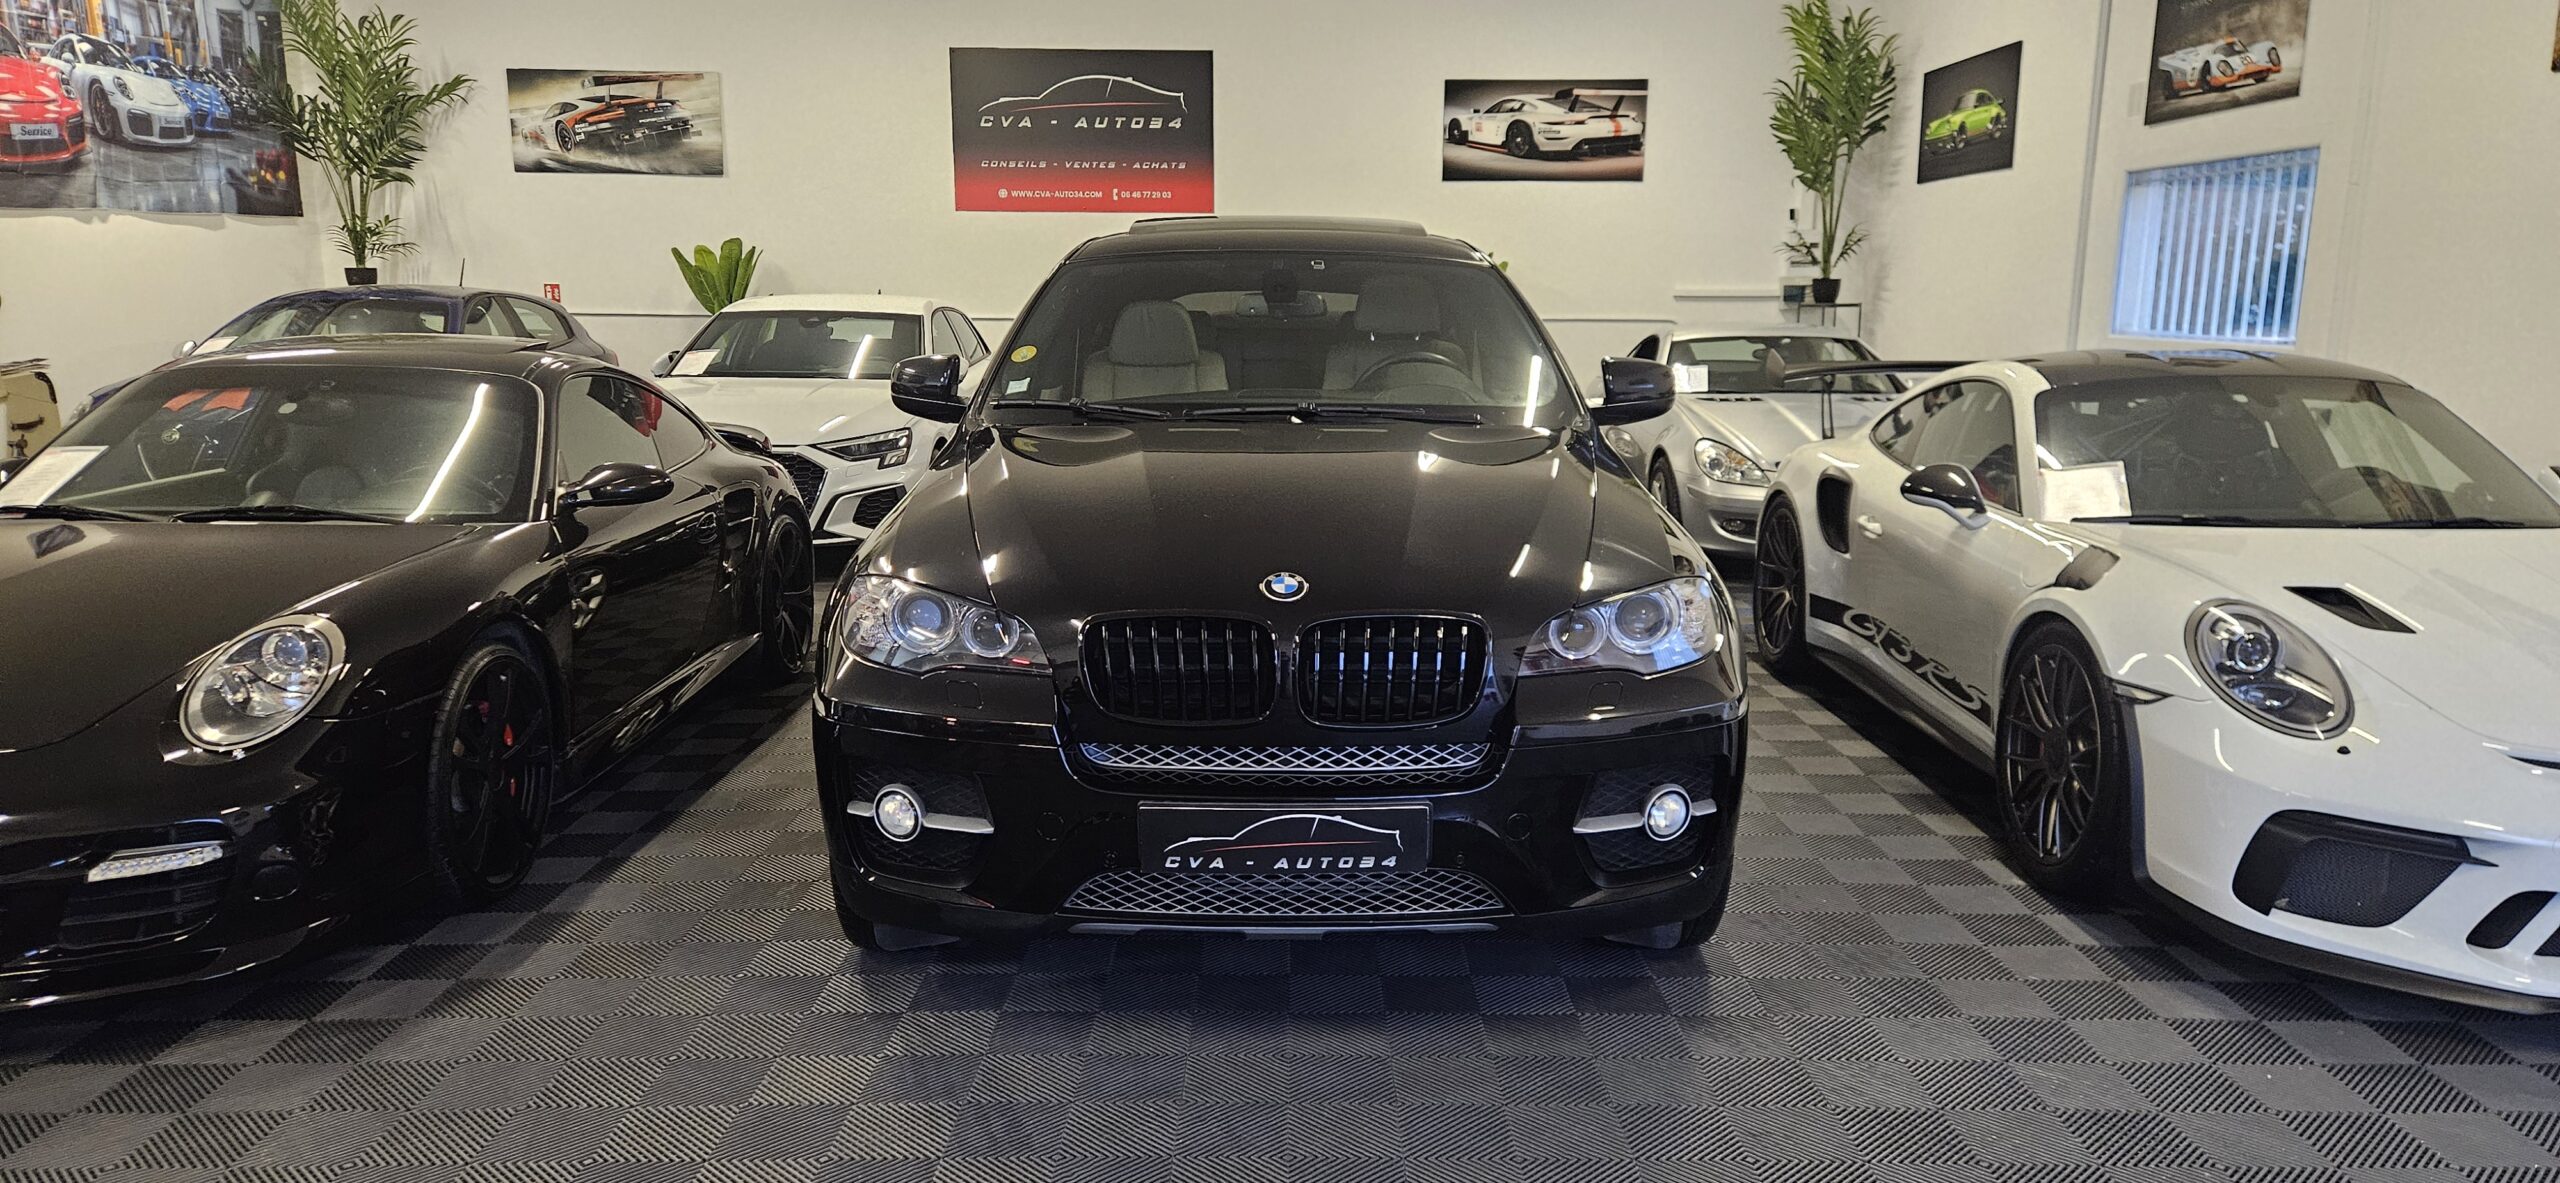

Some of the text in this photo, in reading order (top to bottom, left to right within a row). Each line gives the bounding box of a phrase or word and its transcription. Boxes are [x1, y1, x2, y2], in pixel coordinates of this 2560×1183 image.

[979, 115, 1032, 128] CVA
[1074, 116, 1183, 129] AUTO34
[981, 160, 1047, 168] CONSEILS
[1064, 161, 1116, 169] VENTES
[1011, 190, 1103, 199] WWW.CVA-AUTO34.COM
[1142, 191, 1151, 199] 77
[1162, 191, 1171, 199] 03
[1843, 609, 1988, 710] GT3 RS
[1164, 856, 1225, 869] CVA
[1273, 855, 1397, 870] AUTO34
